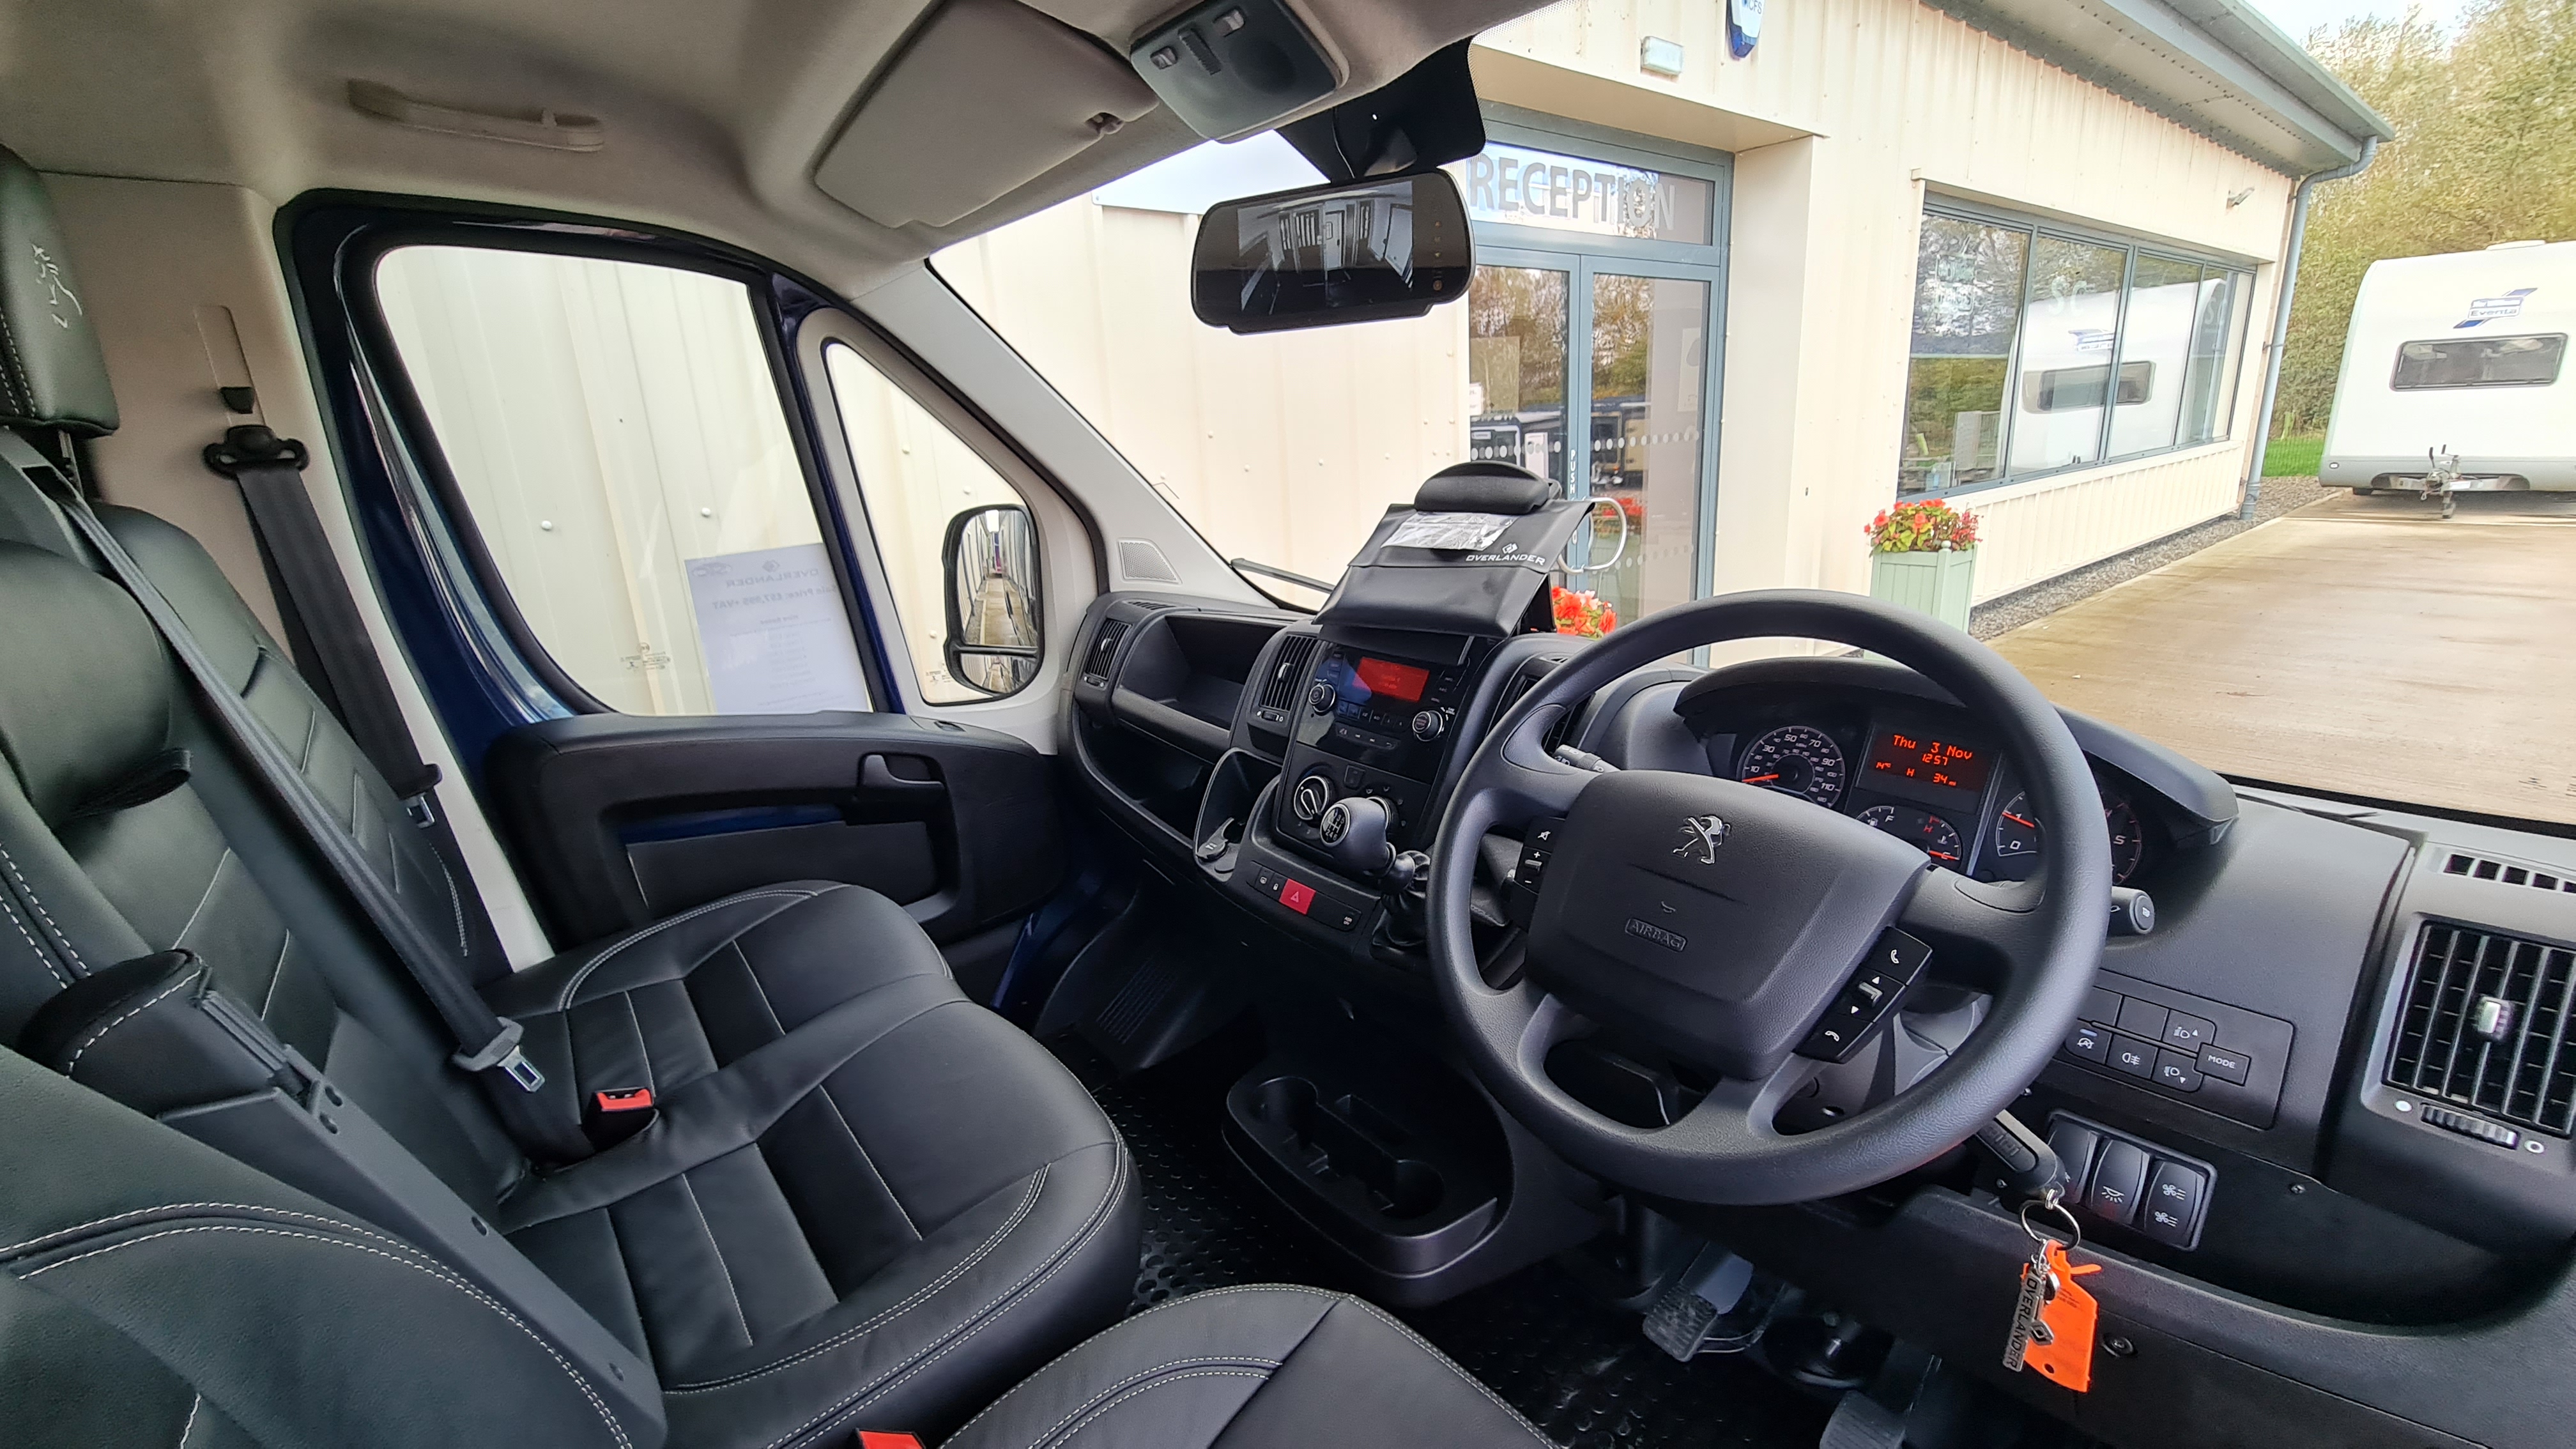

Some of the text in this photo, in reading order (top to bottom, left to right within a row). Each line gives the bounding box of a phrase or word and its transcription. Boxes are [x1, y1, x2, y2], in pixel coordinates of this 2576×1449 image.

[1469, 153, 1676, 231] RECEPTION
[2470, 309, 2517, 317] Eventa
[1465, 554, 1546, 565] OVERLANDER
[1784, 733, 1798, 742] 50
[1808, 739, 1821, 747] 70
[1893, 734, 1974, 760] Thu 3 Nov
[1762, 744, 1775, 753] 30
[1821, 757, 1836, 767] 90
[1906, 767, 1915, 777] H
[1821, 782, 1836, 792] 110
[1885, 815, 1894, 823] F
[2113, 834, 2127, 845] 5
[1630, 921, 1682, 948] AIRBAG
[2207, 1054, 2235, 1069] MODE
[2006, 1278, 2038, 1371] OVERLANDER
